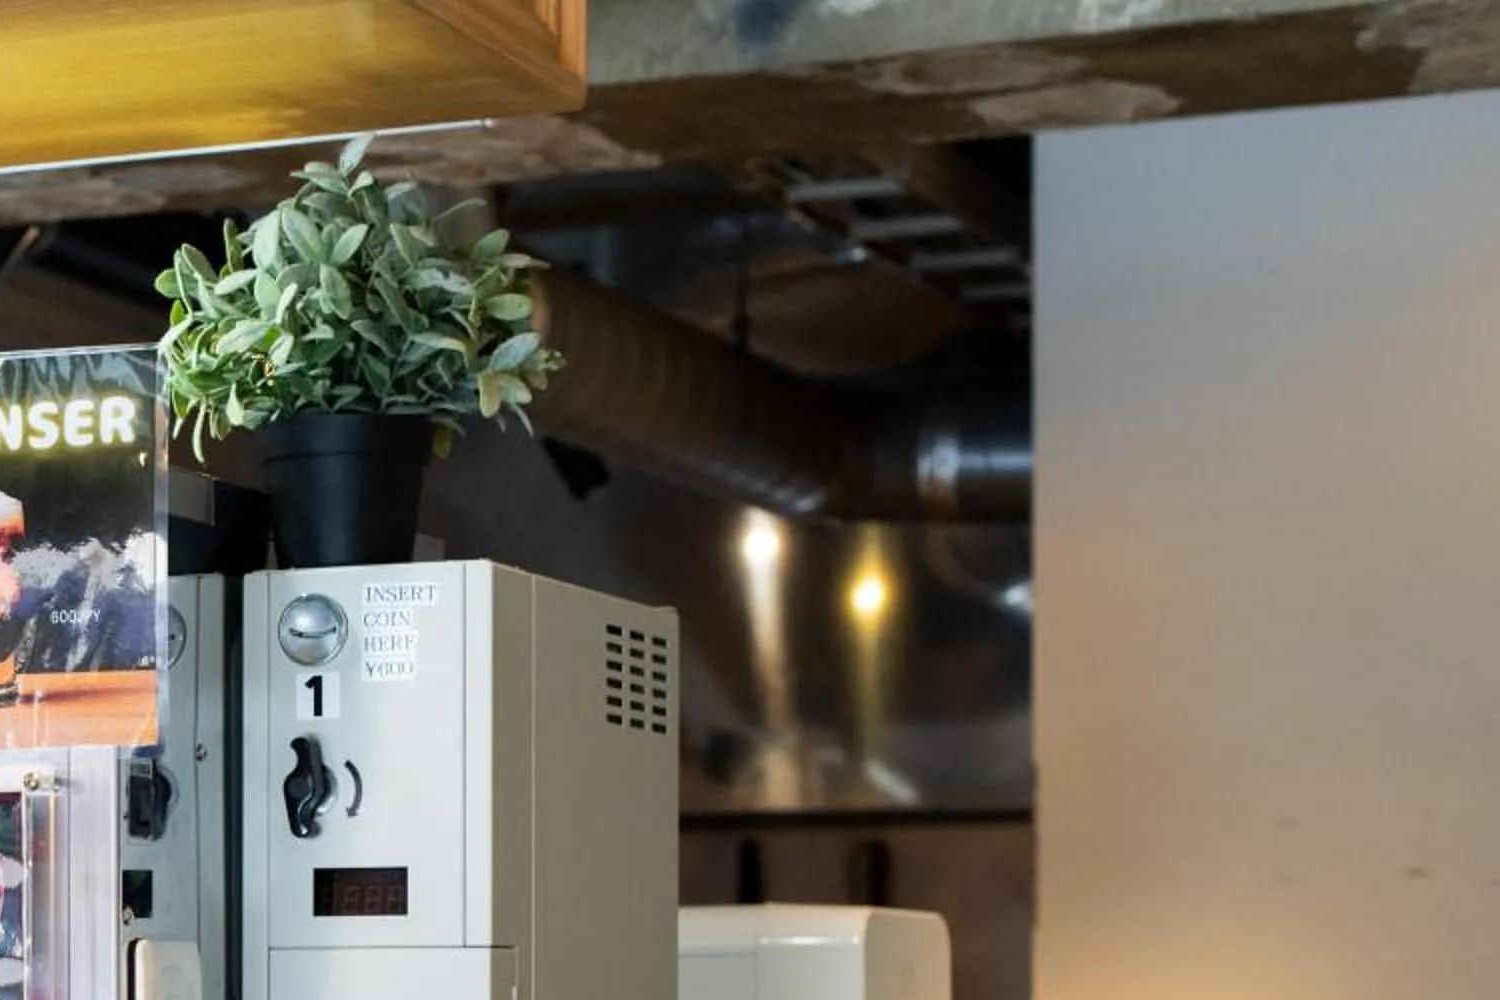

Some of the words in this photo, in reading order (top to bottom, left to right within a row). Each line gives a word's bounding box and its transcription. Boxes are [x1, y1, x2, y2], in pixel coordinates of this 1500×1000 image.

[365, 585, 438, 603] INSERT
[363, 610, 411, 628] COIN
[304, 674, 323, 717] 1
